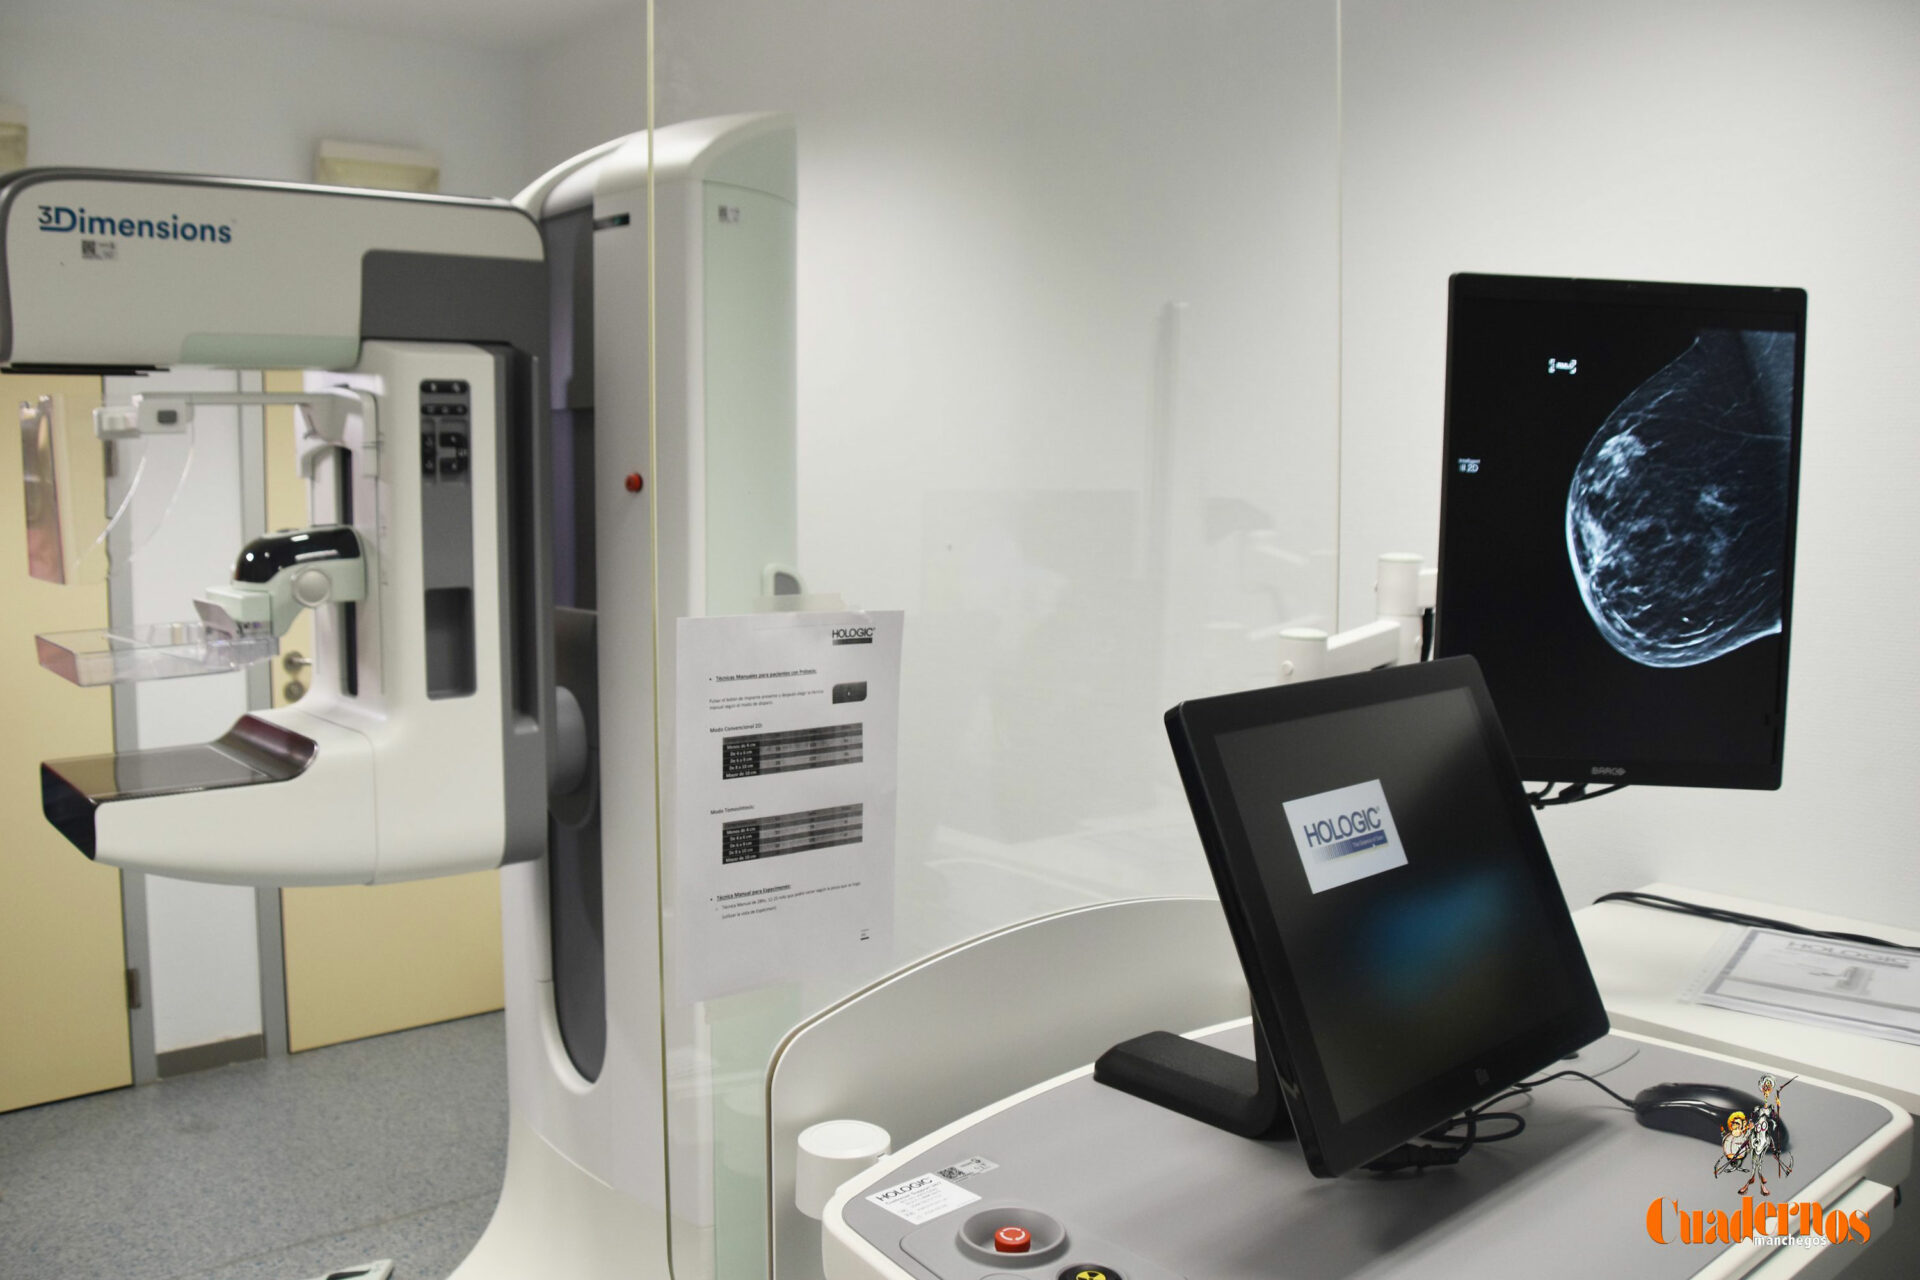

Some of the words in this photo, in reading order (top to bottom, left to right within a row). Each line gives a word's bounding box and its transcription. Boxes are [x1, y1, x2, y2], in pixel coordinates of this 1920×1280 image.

[38, 205, 232, 244] 3Dimensions
[832, 627, 873, 639] HOLOGIC
[1303, 807, 1382, 848] HOLOGIC
[875, 1177, 933, 1202] HOLOGIC
